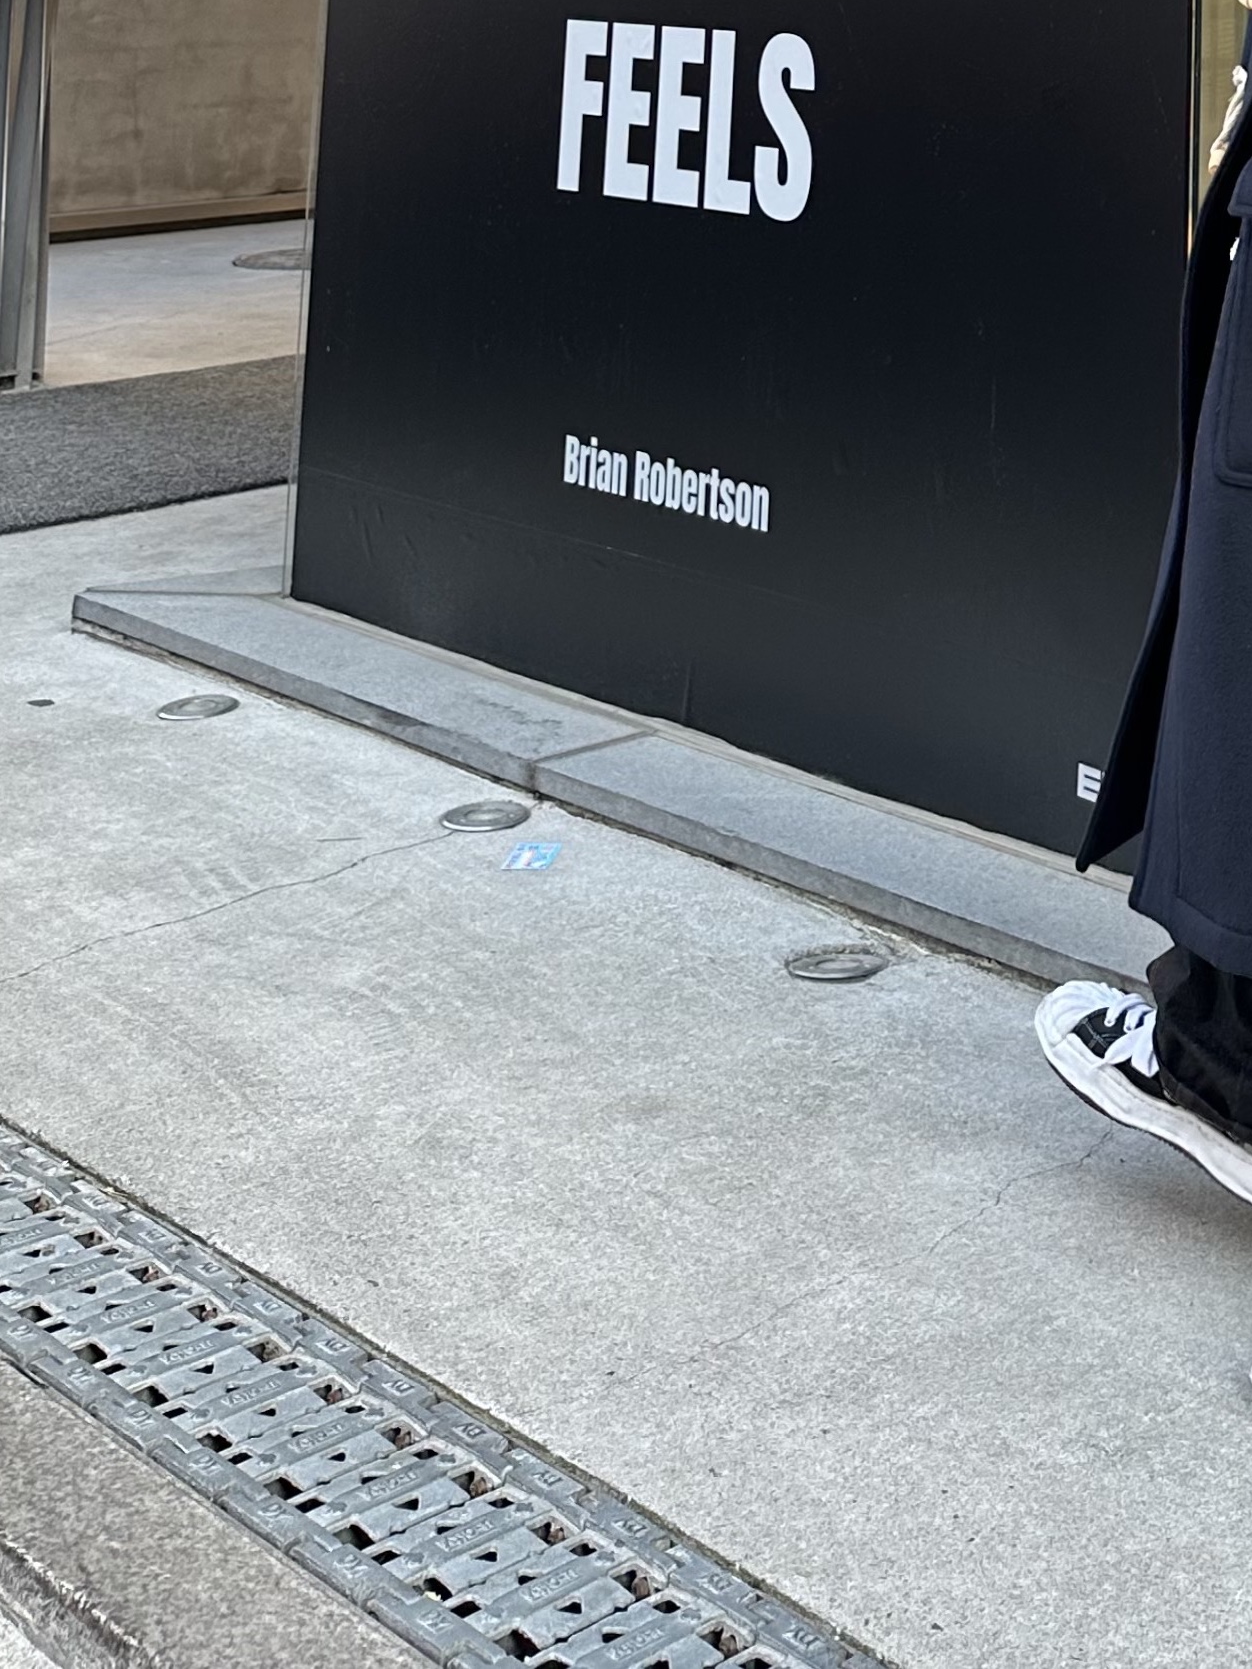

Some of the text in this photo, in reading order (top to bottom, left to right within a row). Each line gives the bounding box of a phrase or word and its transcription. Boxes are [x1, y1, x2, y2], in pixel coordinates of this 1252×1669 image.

[557, 19, 815, 221] FEELS
[564, 435, 769, 532] Brian Robertson
